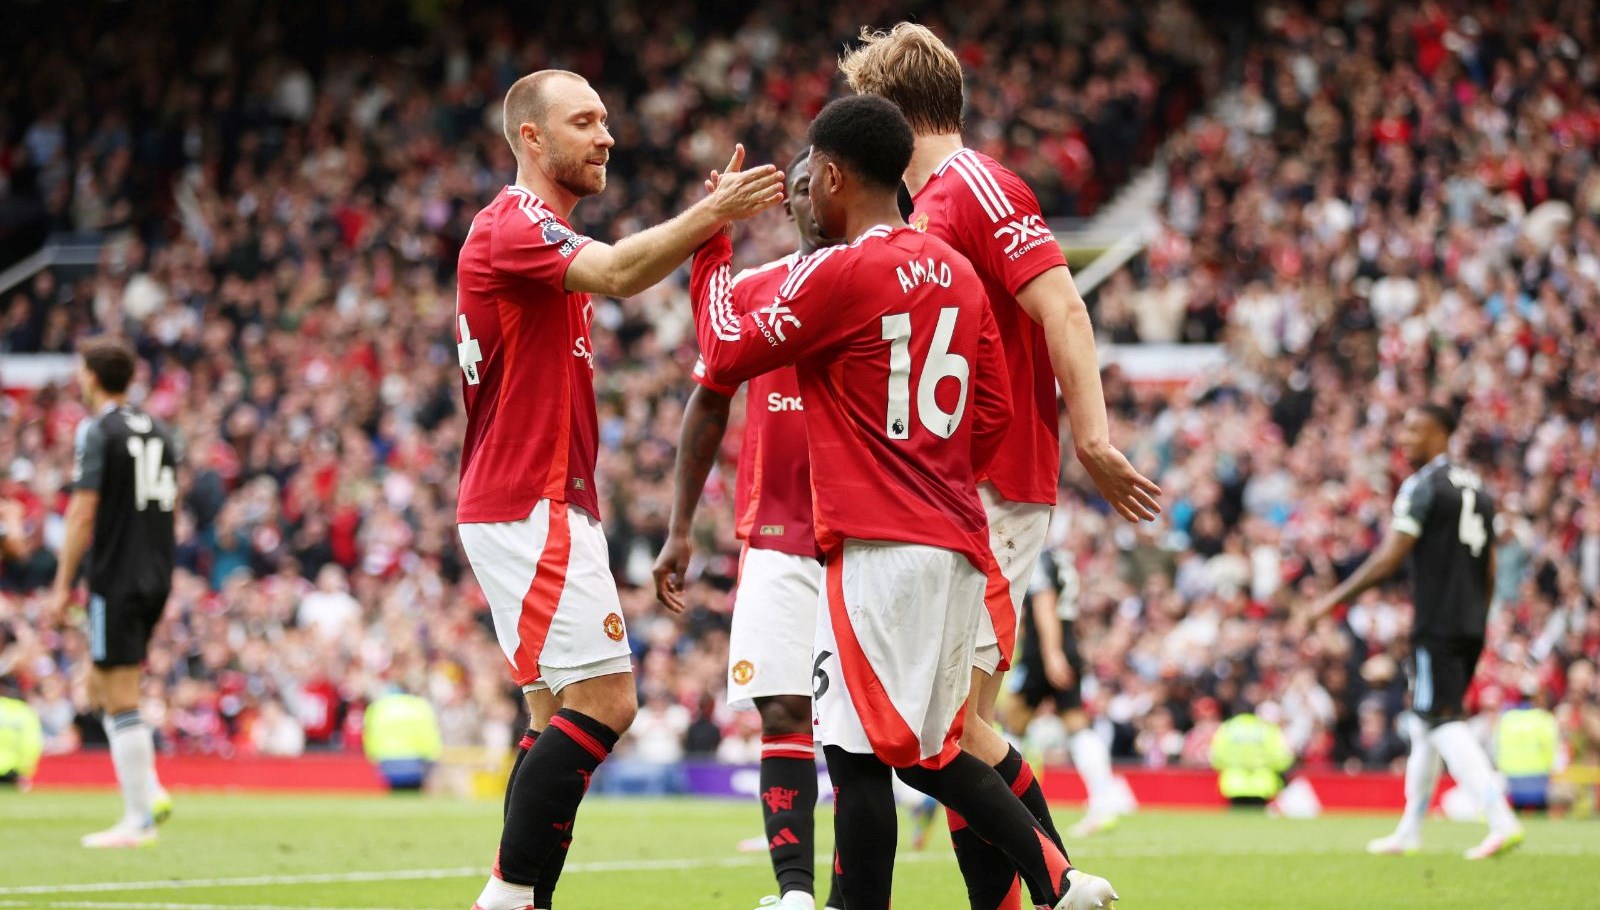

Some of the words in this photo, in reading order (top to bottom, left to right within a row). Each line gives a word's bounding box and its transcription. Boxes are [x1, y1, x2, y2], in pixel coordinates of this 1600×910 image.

[896, 257, 951, 294] AMAD
[760, 295, 802, 342] XC
[881, 306, 970, 440] 16
[126, 435, 178, 512] 14
[1458, 487, 1488, 558] 4
[811, 649, 833, 701] 6
